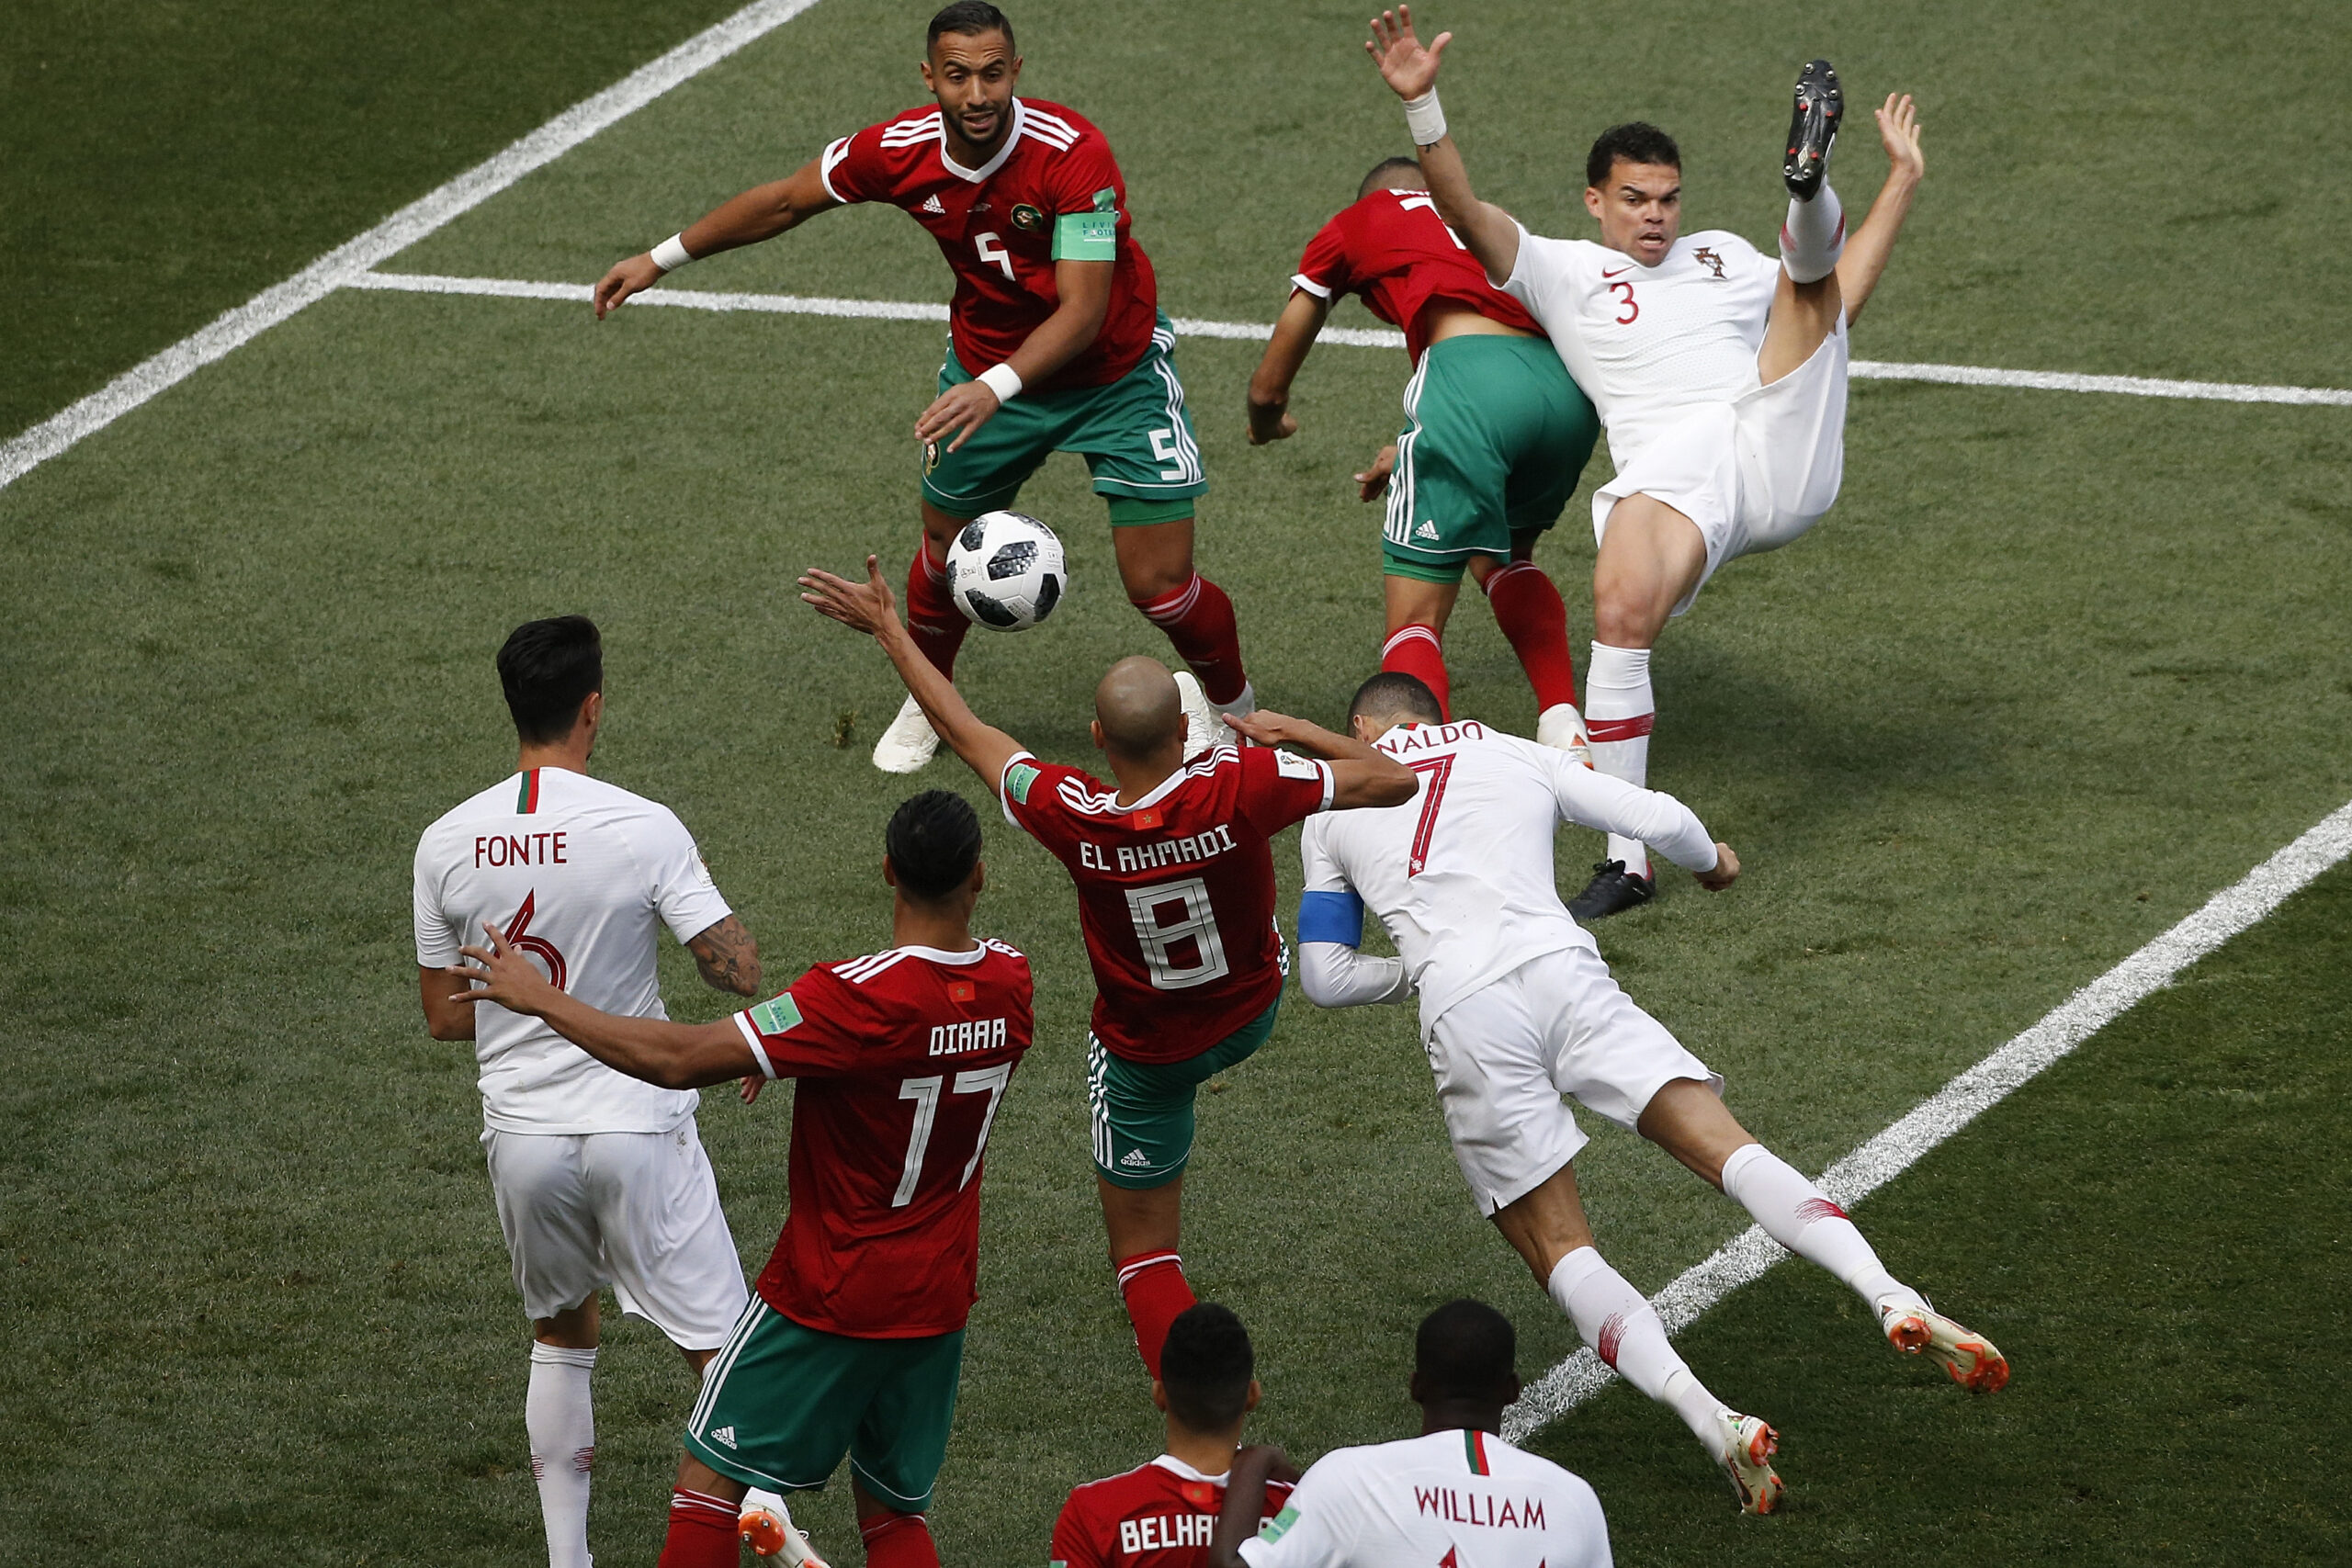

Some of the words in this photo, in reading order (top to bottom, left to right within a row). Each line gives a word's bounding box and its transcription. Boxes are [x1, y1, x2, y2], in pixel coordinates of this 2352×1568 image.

[922, 203, 945, 214] adidas
[975, 231, 1016, 281] 5
[1609, 281, 1639, 325] 3
[1148, 428, 1187, 481] 5
[1415, 530, 1440, 541] adidas
[1376, 721, 1483, 755] NALDO
[1404, 752, 1457, 879] 7
[475, 831, 567, 869] FONTE
[1080, 841, 1112, 871] EL
[1116, 824, 1238, 873] AHMADI
[493, 887, 568, 992] 6
[1124, 876, 1230, 991] 8
[929, 1017, 1007, 1056] DIRAR
[891, 1061, 1012, 1208] 17
[1120, 1158, 1150, 1167] adidas
[710, 1430, 738, 1450] adidas
[1414, 1485, 1546, 1531] WILLIAM
[1120, 1515, 1274, 1554] BELHA
